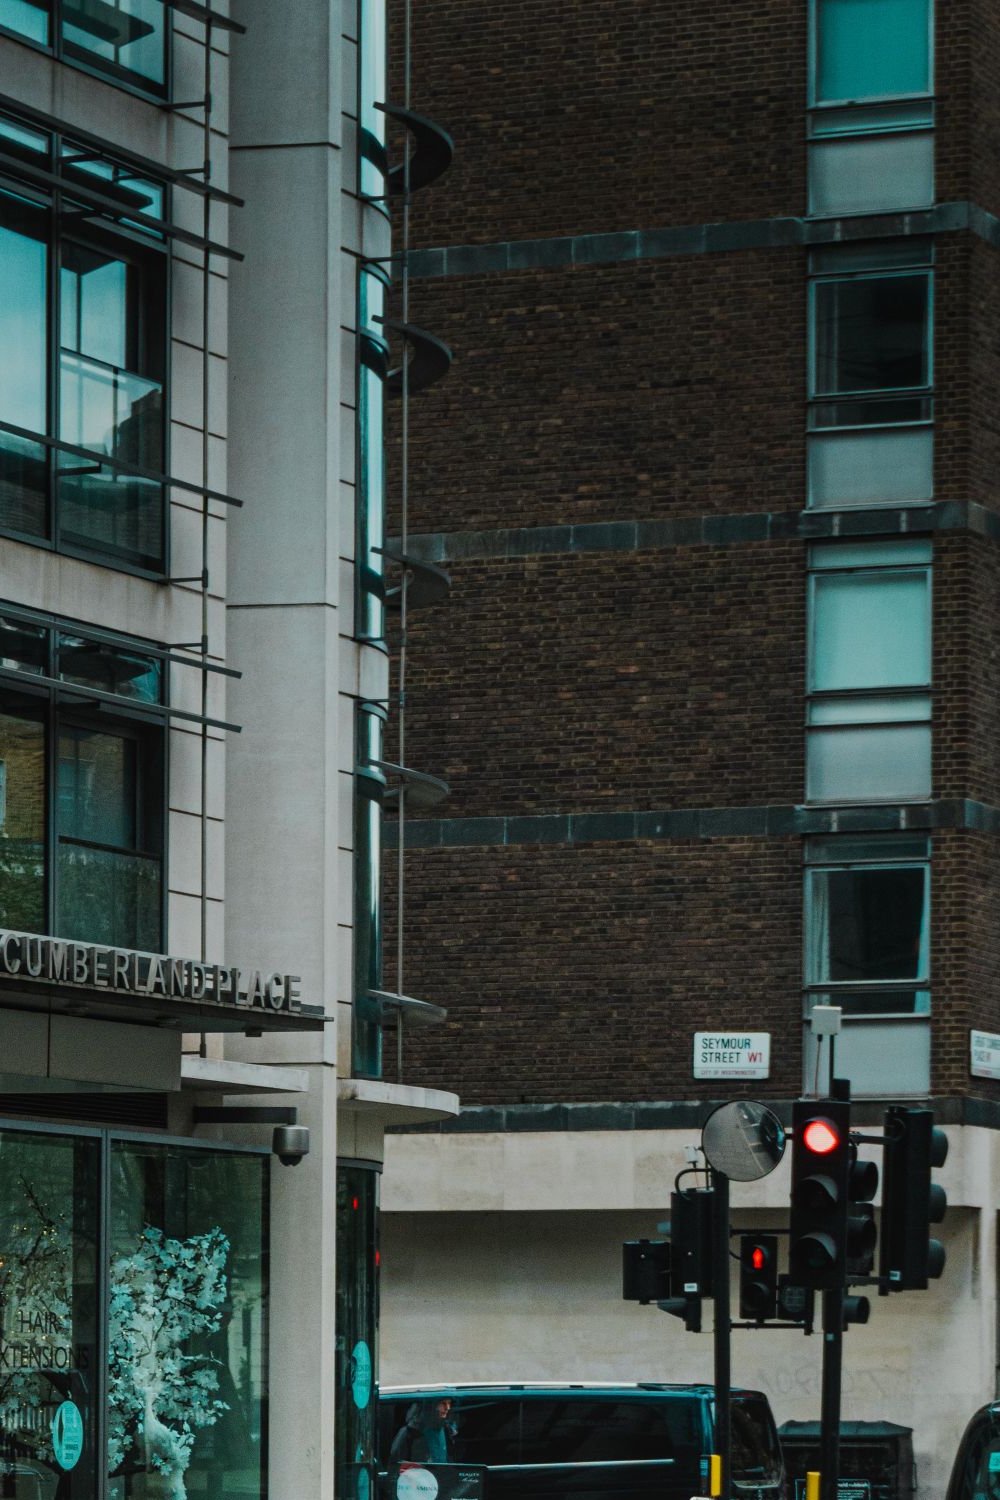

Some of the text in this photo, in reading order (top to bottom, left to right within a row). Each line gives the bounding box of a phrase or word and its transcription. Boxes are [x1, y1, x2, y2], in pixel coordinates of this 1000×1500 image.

[0, 933, 206, 999] CUMBERLAND
[213, 964, 301, 1013] PLACE
[701, 1038, 751, 1050] SEYMOUR
[701, 1052, 762, 1063] STREET W1
[19, 1311, 59, 1334] HAIR
